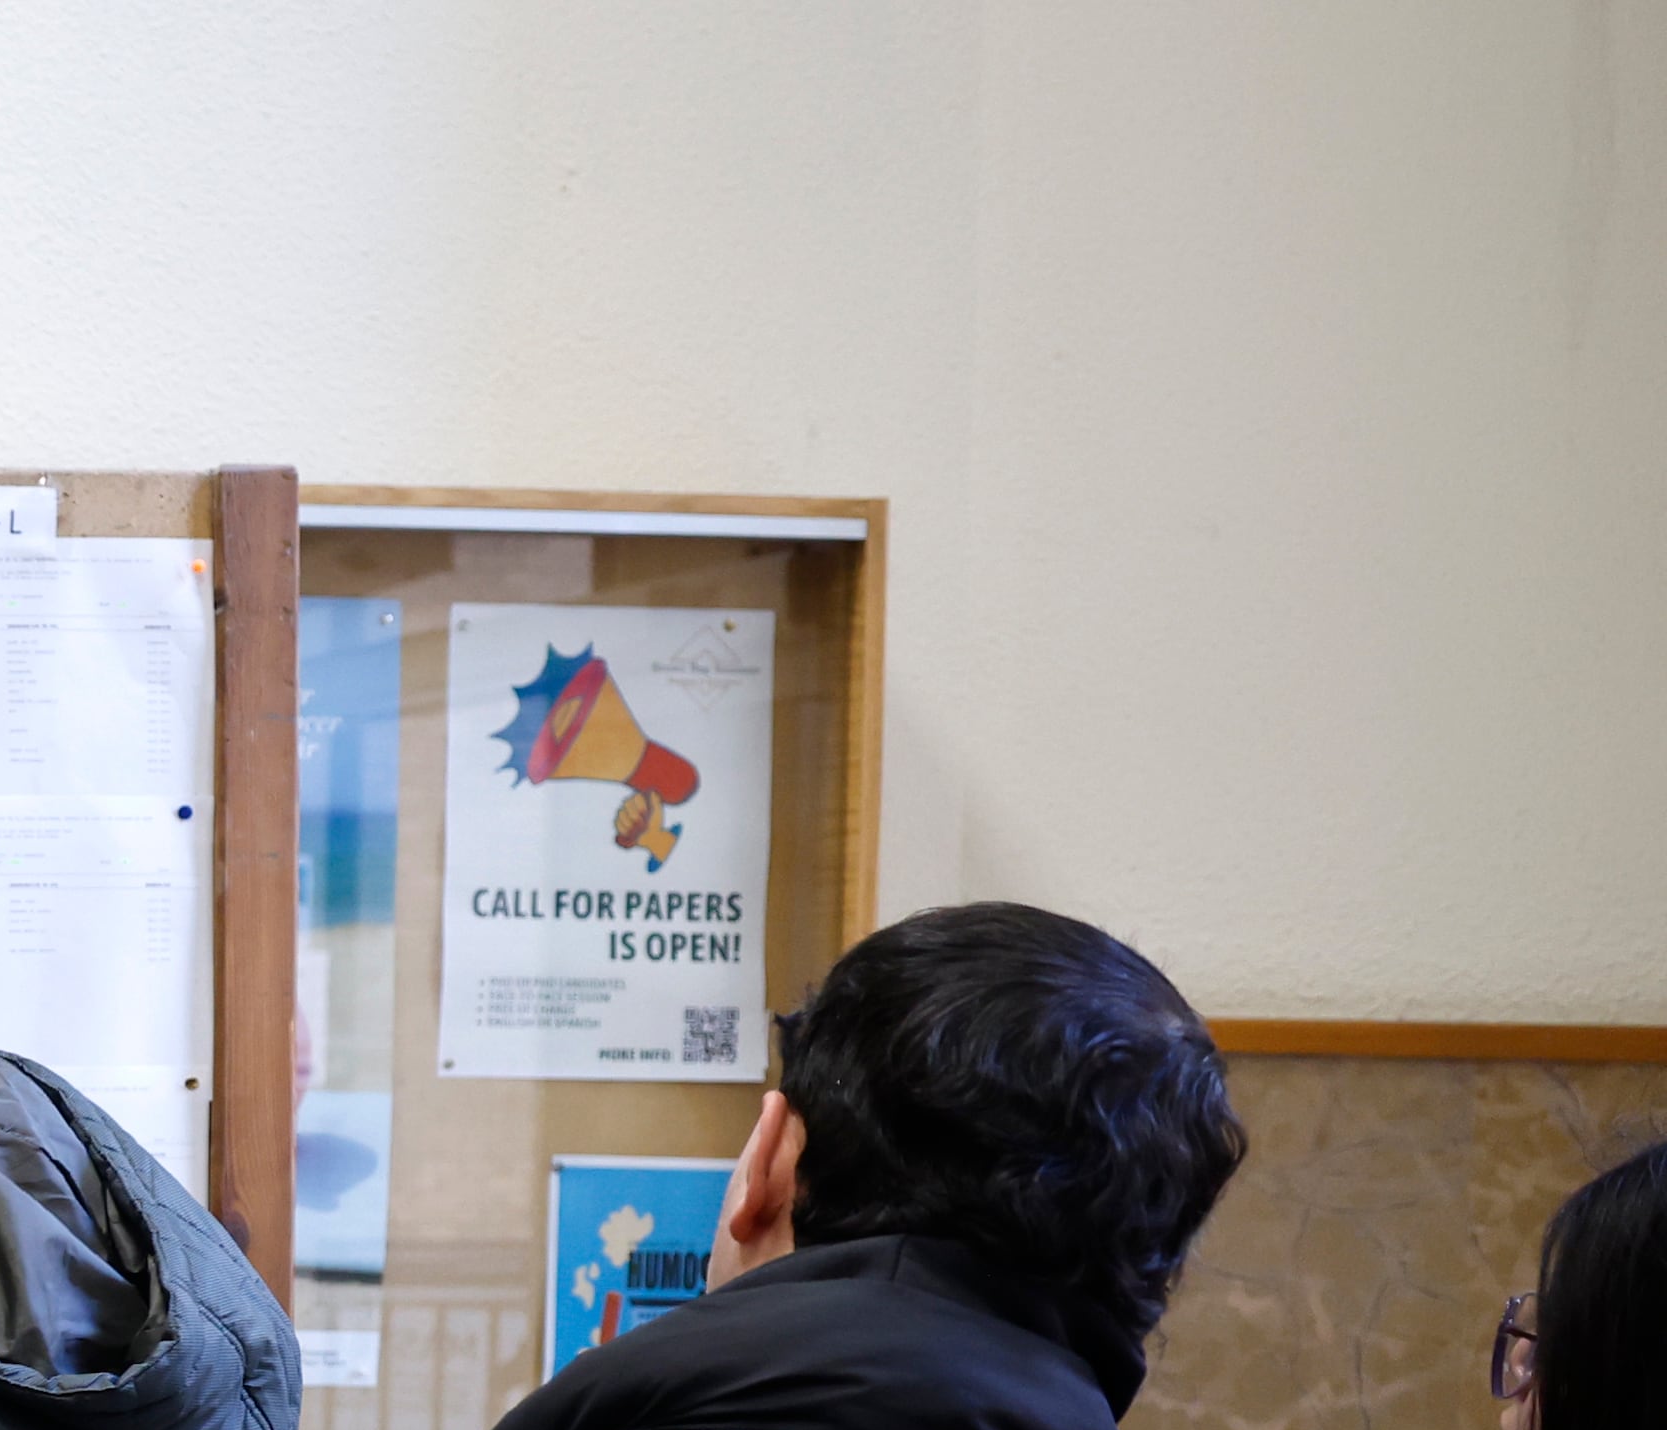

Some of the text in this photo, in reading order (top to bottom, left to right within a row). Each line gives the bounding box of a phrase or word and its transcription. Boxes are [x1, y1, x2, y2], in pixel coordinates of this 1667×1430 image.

[472, 888, 743, 922] CALL FOR PAPERS
[610, 931, 743, 963] IS OPEN!
